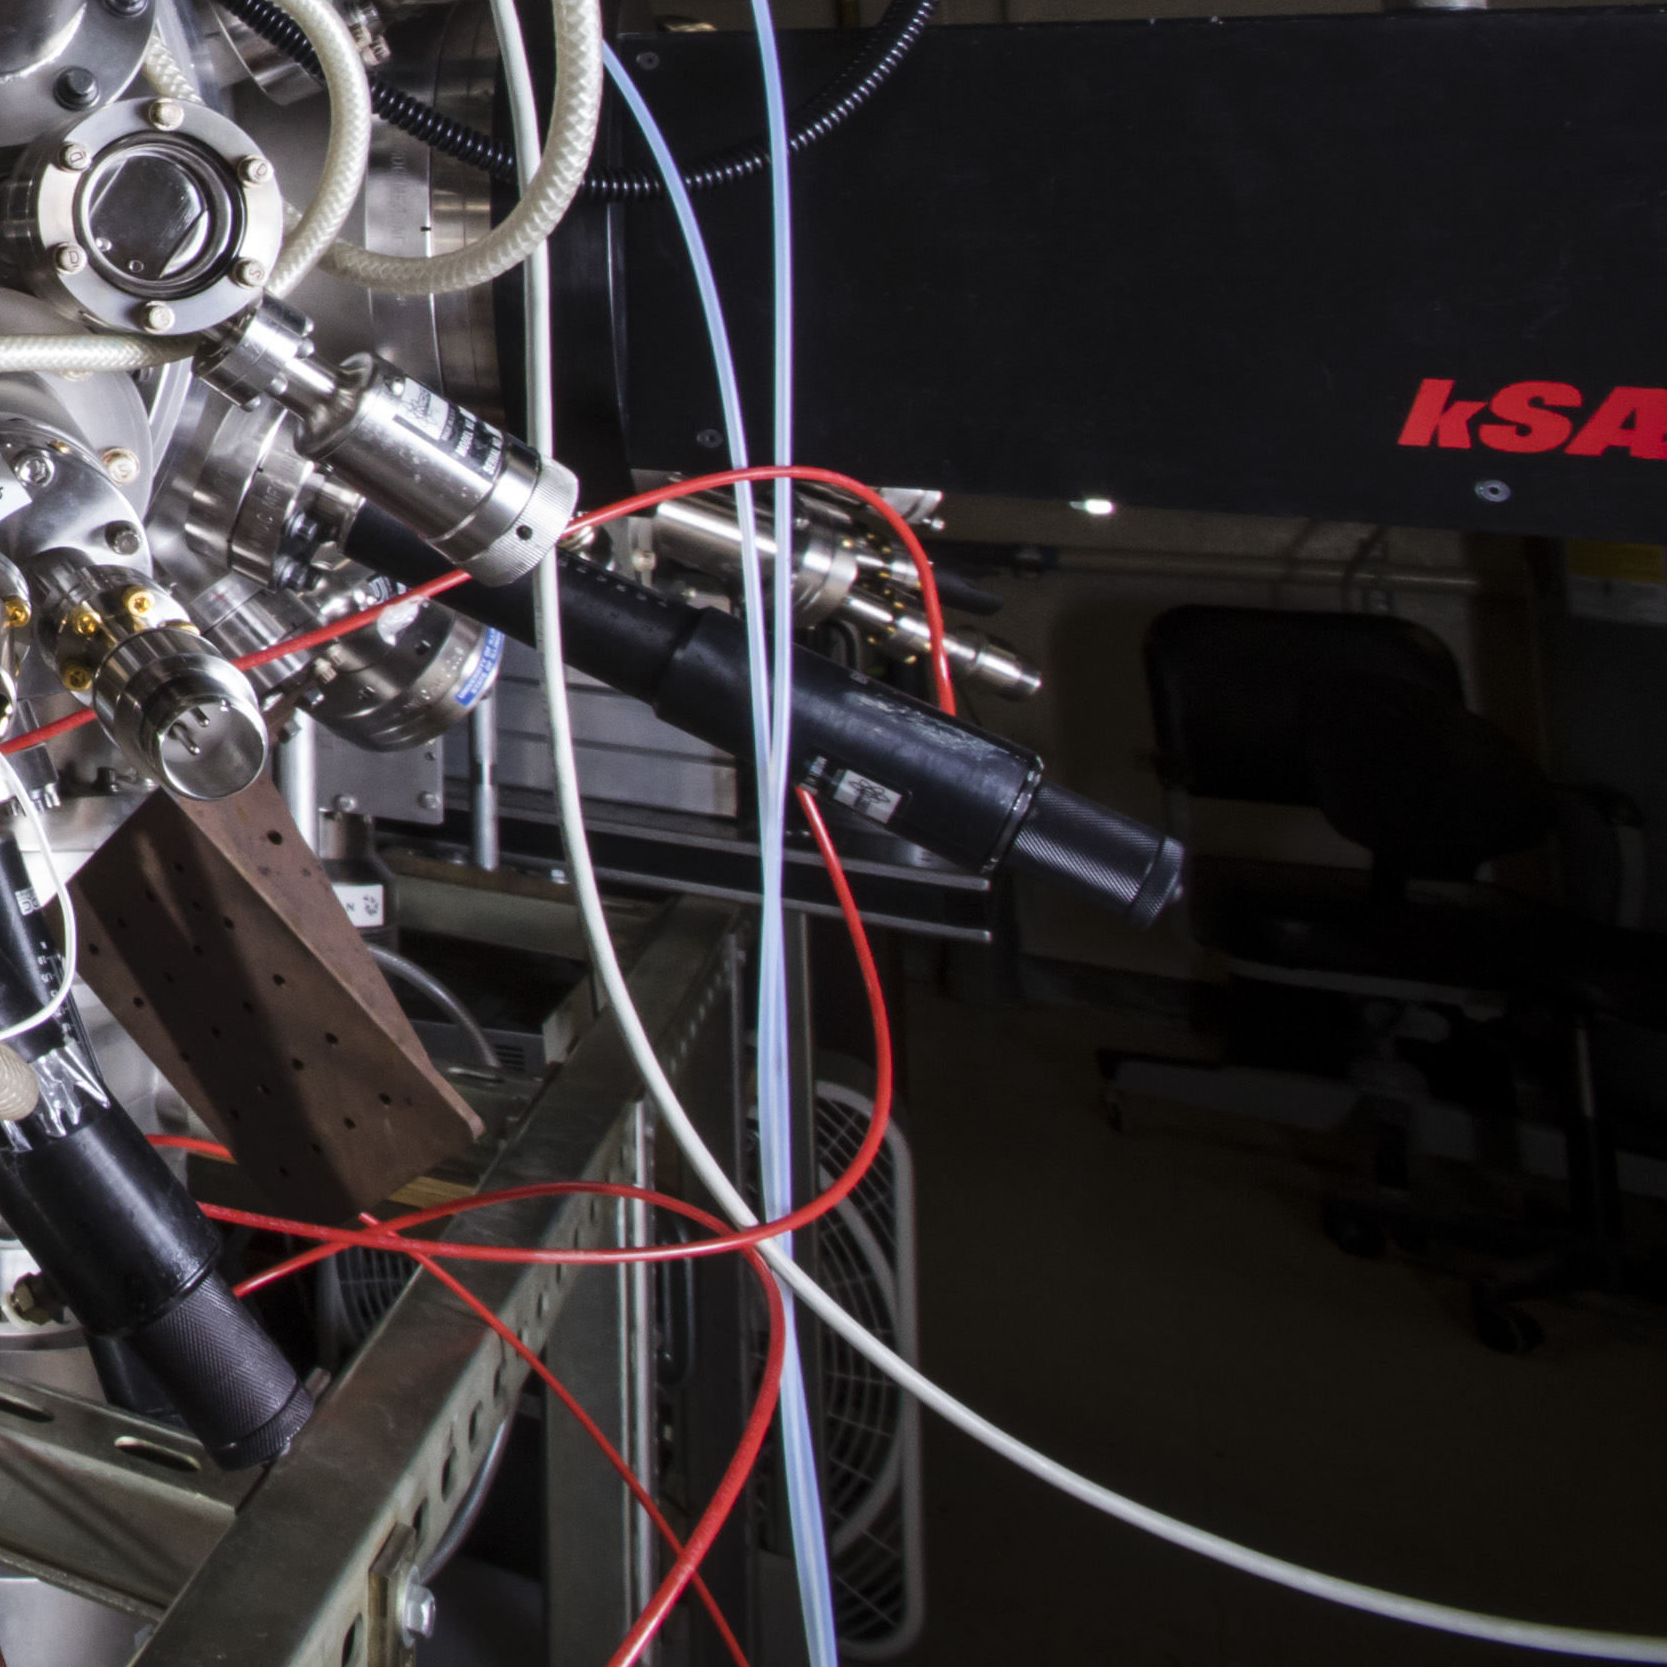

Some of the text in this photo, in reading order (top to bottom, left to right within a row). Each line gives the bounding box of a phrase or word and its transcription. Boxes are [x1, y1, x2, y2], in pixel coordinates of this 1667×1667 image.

[1397, 378, 1667, 460] kSA
[454, 427, 474, 457] MODEL
[481, 446, 501, 475] SERIAL
[469, 670, 489, 695] STATE
